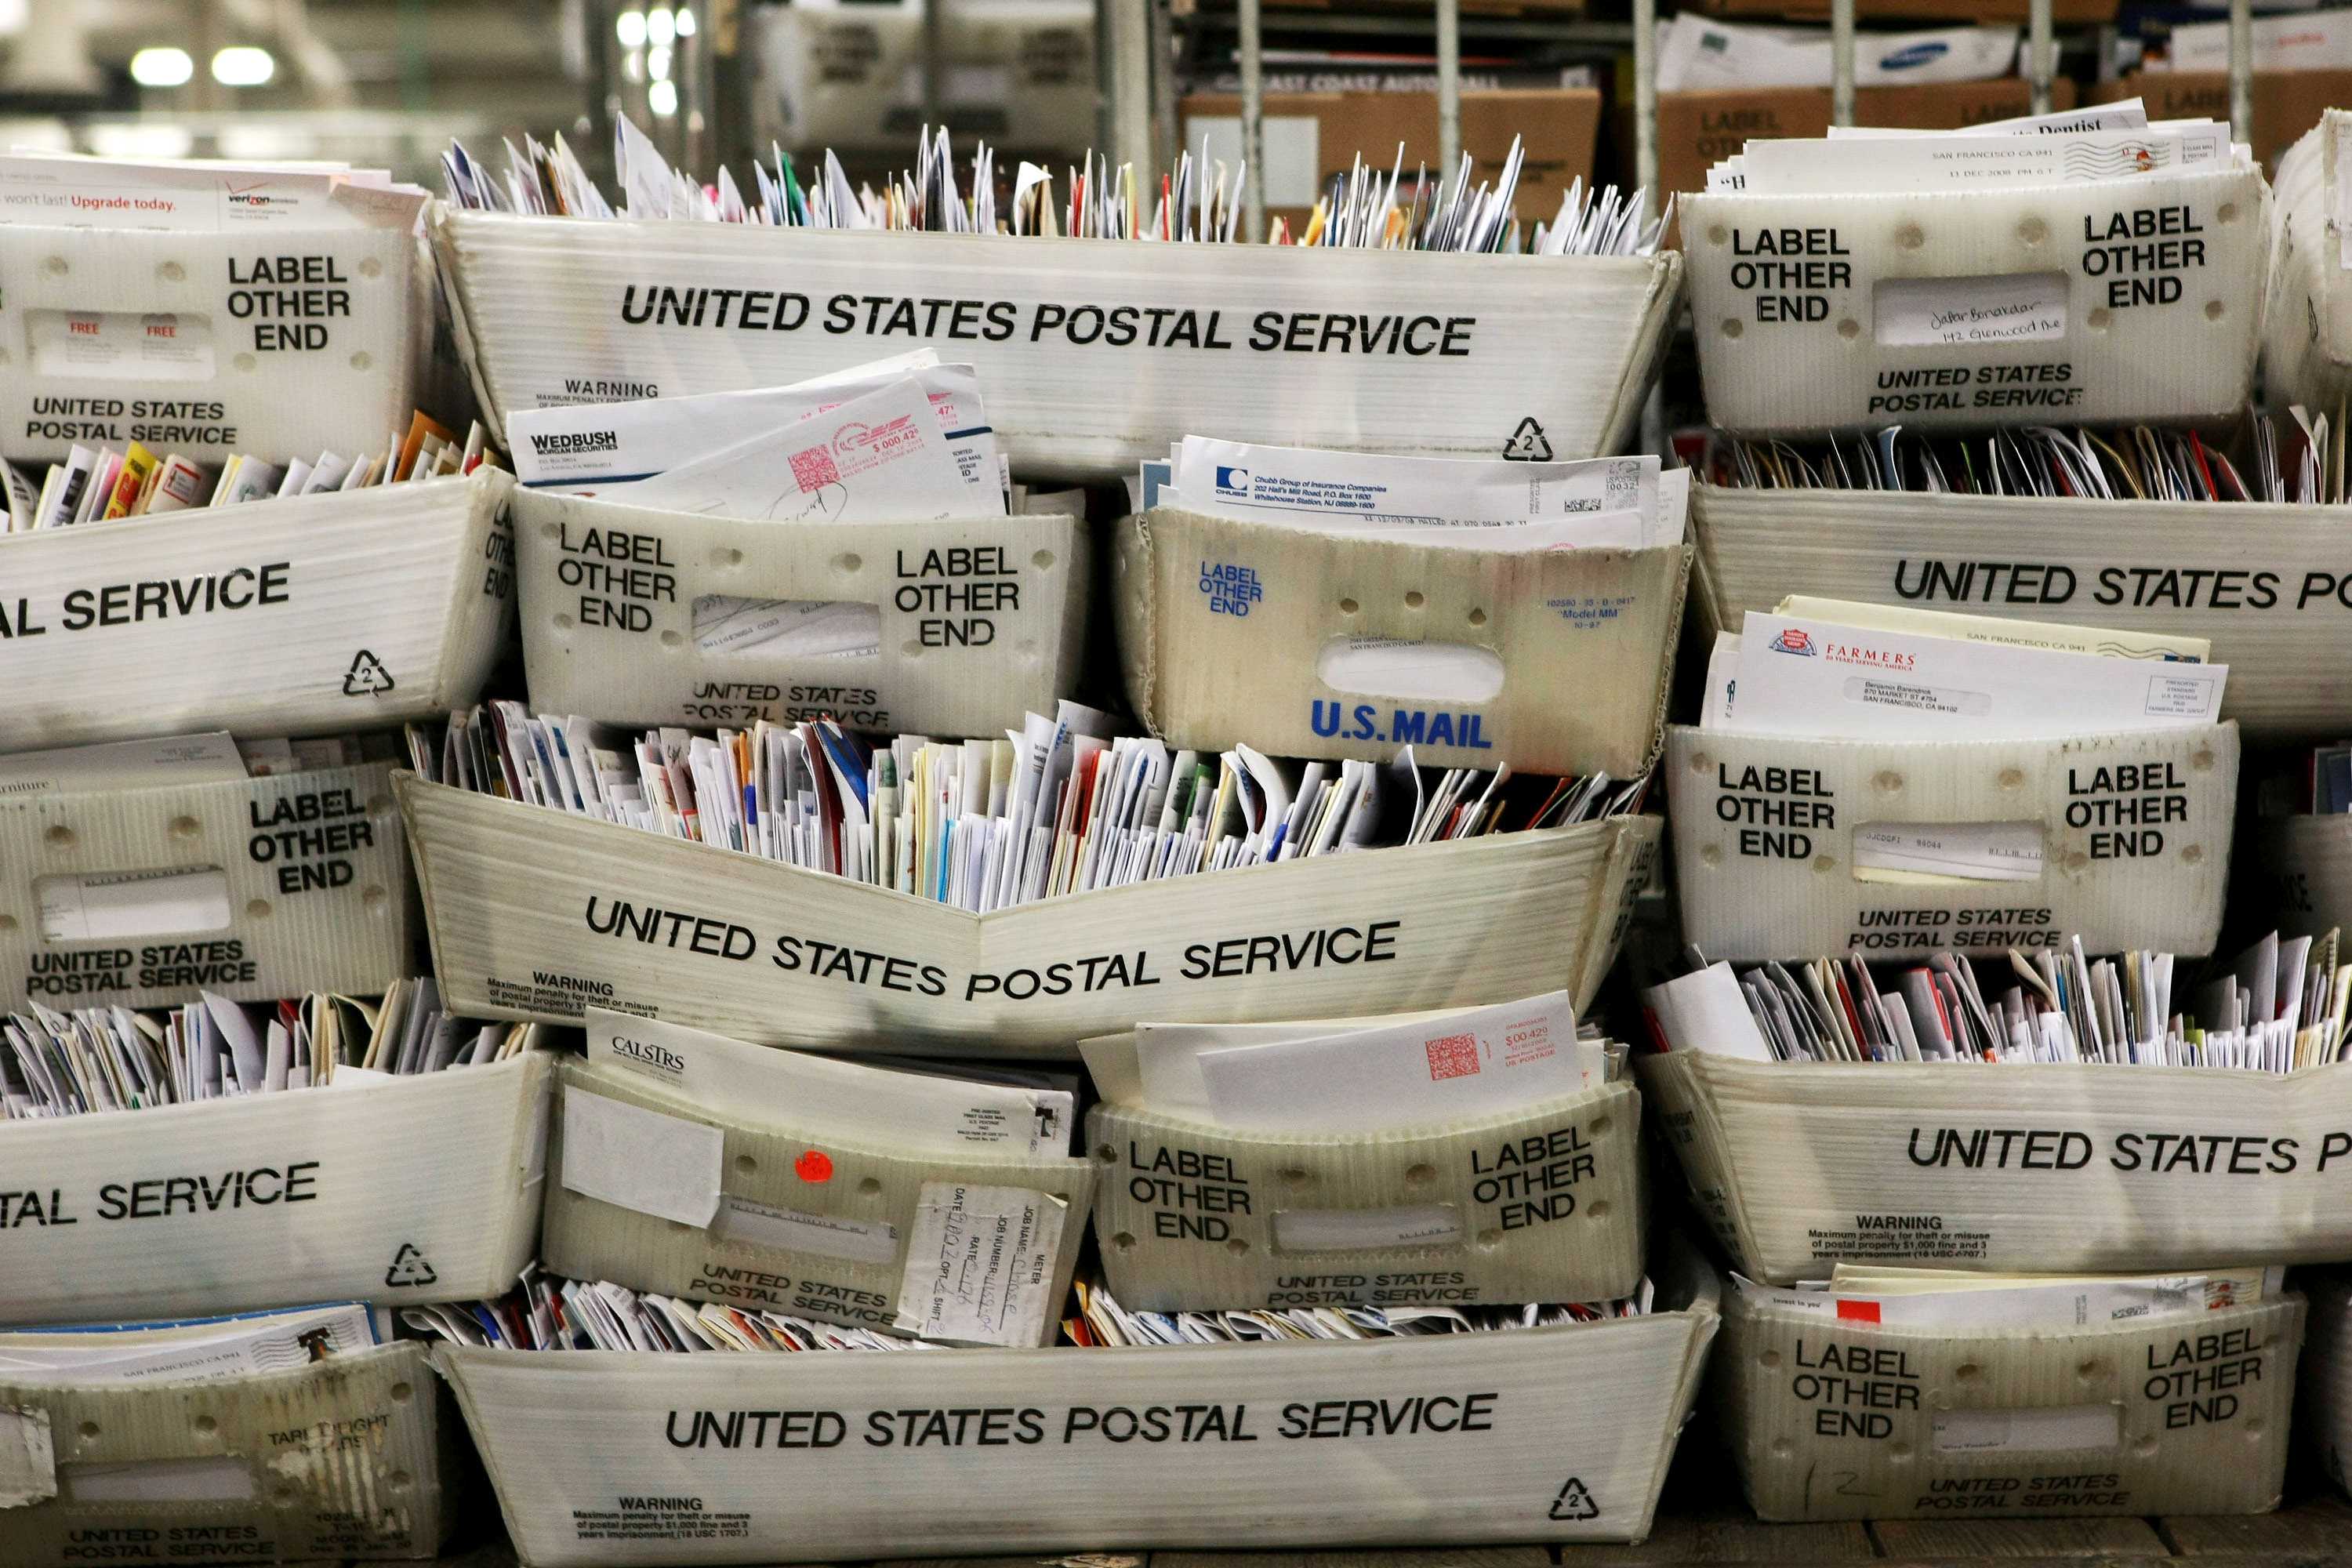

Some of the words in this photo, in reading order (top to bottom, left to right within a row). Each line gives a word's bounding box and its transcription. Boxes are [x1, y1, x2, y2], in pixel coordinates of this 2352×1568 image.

[71, 195, 130, 211] Upgrade
[134, 198, 176, 212] today.
[228, 194, 270, 206] verizon
[2084, 205, 2204, 243] LABEL
[1733, 228, 1850, 257] LABEL
[2082, 238, 2206, 276] OTHER
[228, 256, 347, 285] LABEL
[1730, 261, 1852, 290] OTHER
[227, 289, 350, 318] OTHER
[2107, 274, 2183, 309] END
[621, 284, 809, 331] UNITED
[823, 294, 1018, 342] STATES
[1030, 303, 1232, 350] POSTAL
[1249, 311, 1477, 358] SERVICE
[1755, 294, 1830, 323] END
[71, 322, 100, 335] FREE
[147, 326, 176, 338] FREE
[254, 323, 328, 351] END
[565, 379, 659, 398] WARNING
[1877, 367, 1969, 390] UNITED
[1976, 363, 2072, 384] STATES
[33, 397, 124, 417] UNITED
[131, 401, 225, 420] STATES
[1868, 389, 1965, 414] POSTAL
[1973, 387, 2082, 408] SERVICE
[26, 420, 123, 441] POSTAL
[129, 423, 238, 445] SERVICE
[531, 430, 618, 448] WEDBUSH
[572, 444, 619, 454] SECURITIES
[1215, 488, 1248, 498] CHUBB
[1254, 475, 1278, 485] Chubb
[1279, 477, 1301, 488] Group
[1311, 481, 1346, 491] Insurance
[1347, 484, 1388, 494] Companies
[1254, 493, 1296, 504] Whitehouse
[1296, 497, 1323, 506] Station,
[559, 522, 676, 570] LABEL
[895, 546, 1018, 579] LABEL
[1200, 560, 1262, 588] LABEL
[557, 558, 677, 603] OTHER
[1199, 579, 1263, 603] OTHER
[1893, 559, 2077, 605] UNITED
[2093, 566, 2281, 611] STATES
[62, 561, 291, 632] SERVICE
[895, 583, 1020, 614] OTHER
[1210, 597, 1250, 618] END
[579, 597, 653, 633] END
[919, 619, 996, 648] END
[1991, 635, 2049, 648] FRANCISCO
[1826, 643, 1916, 665] FARMERS
[694, 682, 780, 701] UNITED
[789, 685, 877, 706] STATES
[1865, 681, 1896, 691] Benjamin
[1878, 689, 1908, 699] MARKET
[1311, 699, 1386, 742] U.S.
[1392, 709, 1494, 750] MAIL
[1718, 761, 1835, 798] LABEL
[2068, 761, 2187, 796] LABEL
[249, 787, 366, 829] LABEL
[1715, 794, 1835, 830] OTHER
[2065, 794, 2189, 829] OTHER
[249, 822, 374, 864] OTHER
[1739, 829, 1813, 860] END
[2089, 829, 2164, 860] END
[277, 859, 354, 895] END
[1859, 909, 1951, 928] UNITED
[1957, 907, 2053, 927] STATES
[585, 894, 757, 961] UNITED
[771, 935, 948, 996] STATES
[965, 949, 1161, 1002] POSTAL
[1180, 920, 1402, 982] SERVICE
[1847, 930, 1945, 950] POSTAL
[1951, 929, 2062, 949] SERVICE
[31, 946, 134, 975] UNITED
[140, 939, 245, 967] STATES
[26, 970, 131, 998] POSTAL
[140, 961, 257, 990] SERVICE
[488, 977, 532, 993] Maximum
[534, 987, 569, 1002] penalty
[588, 995, 609, 1006] theft
[624, 1001, 660, 1012] misuse
[532, 971, 614, 997] WARNING
[502, 990, 531, 1004] postal
[533, 996, 574, 1010] property
[518, 1000, 585, 1018] imprisonment
[1129, 1141, 1249, 1185] LABEL
[1471, 1127, 1592, 1175] LABEL
[1907, 1127, 2093, 1171] UNITED
[2110, 1133, 2299, 1174] STATES
[96, 1161, 320, 1221] SERVICE
[1472, 1153, 1596, 1205] OTHER
[952, 1187, 965, 1211] DATE
[1129, 1177, 1252, 1215] OTHER
[997, 1214, 1008, 1233] JOB
[1023, 1206, 1035, 1224] JOB
[1501, 1192, 1575, 1232] END
[1857, 1215, 1942, 1230] WARNING
[1154, 1212, 1229, 1243] END
[1809, 1229, 1857, 1239] Maximum
[967, 1236, 979, 1261] RATE
[1825, 1240, 1856, 1250] postal
[1859, 1241, 1900, 1251] property
[1904, 1241, 1936, 1250] $1,000
[1030, 1254, 1045, 1285] METER
[702, 1264, 790, 1291] UNITED
[800, 1281, 887, 1308] STATES
[690, 1279, 786, 1310] POSTAL
[794, 1298, 898, 1327] SERVICE
[930, 1298, 943, 1321] SHIFT
[1795, 1339, 1920, 1379] LABEL
[2147, 1328, 2263, 1370] LABEL
[1792, 1374, 1920, 1411] OTHER
[2144, 1357, 2263, 1400] OTHER
[666, 1410, 847, 1449] UNITED
[863, 1408, 1045, 1447] STATES
[1063, 1406, 1258, 1444] POSTAL
[1278, 1393, 1498, 1439] SERVICE
[1816, 1409, 1893, 1439] END
[2165, 1394, 2240, 1431] END
[619, 1497, 703, 1511] WARNING
